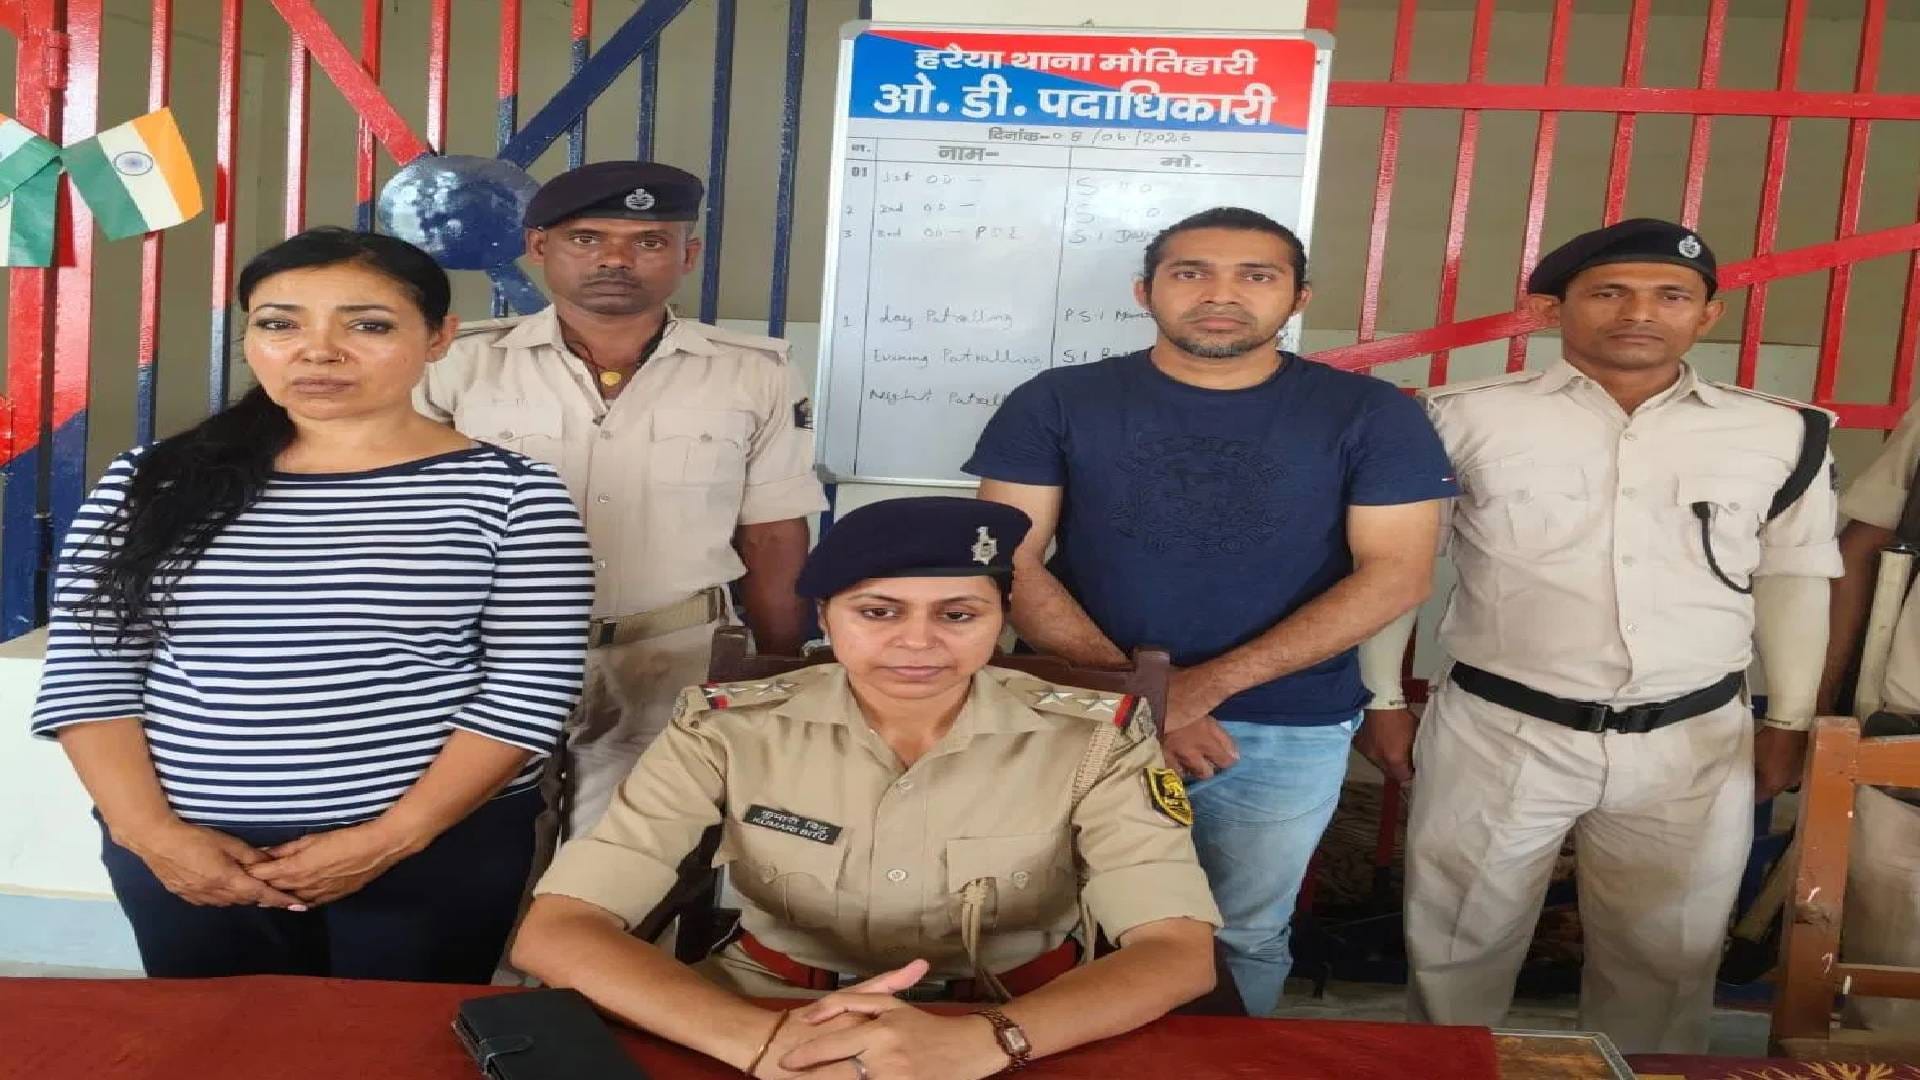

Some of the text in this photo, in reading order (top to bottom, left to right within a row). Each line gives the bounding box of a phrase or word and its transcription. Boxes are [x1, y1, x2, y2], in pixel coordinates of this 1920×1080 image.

[1011, 50, 1094, 71] थाना
[1098, 47, 1258, 76] मोतिहारी
[873, 72, 1279, 126] ओ. डी. पदाधिकारी
